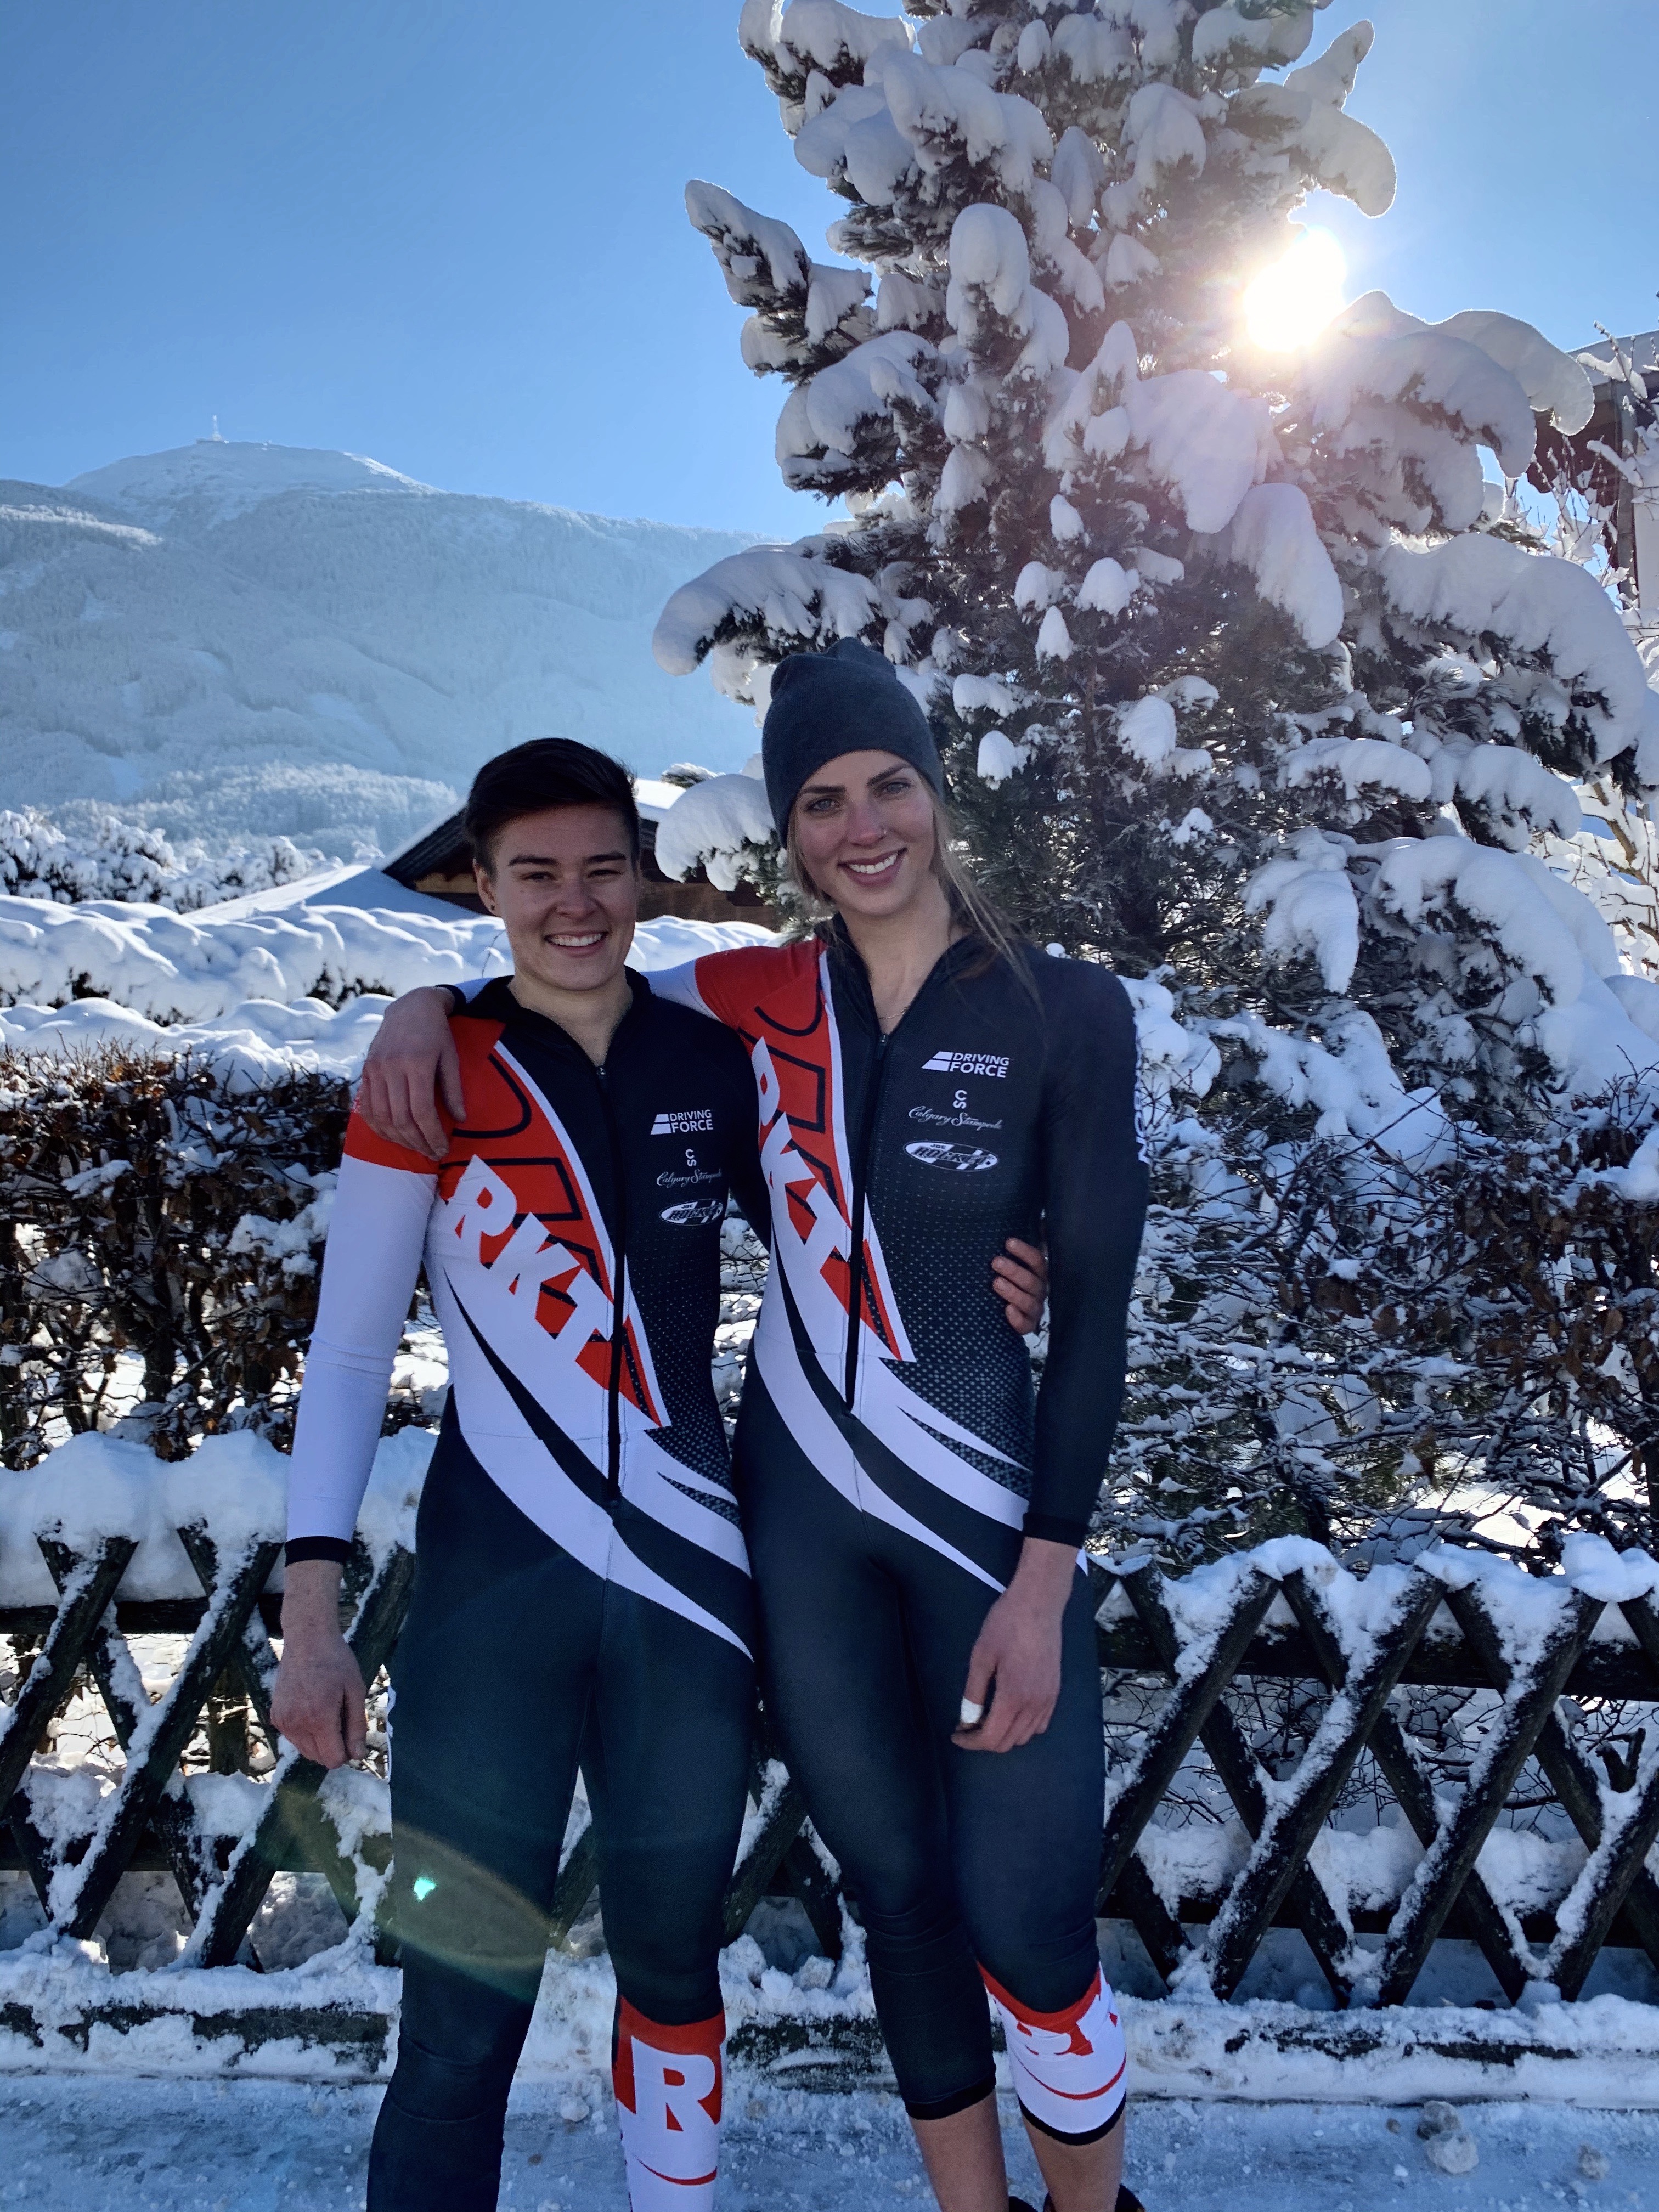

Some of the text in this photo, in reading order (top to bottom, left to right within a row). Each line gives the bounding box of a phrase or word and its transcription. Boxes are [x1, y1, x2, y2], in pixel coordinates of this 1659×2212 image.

[953, 1052, 1010, 1066] DRIVING
[949, 1062, 1008, 1079] FORCE
[669, 1109, 712, 1122] DRIVING
[908, 1105, 952, 1126] Calgary
[671, 1119, 714, 1133] FORCE
[656, 1171, 690, 1188] Calgary
